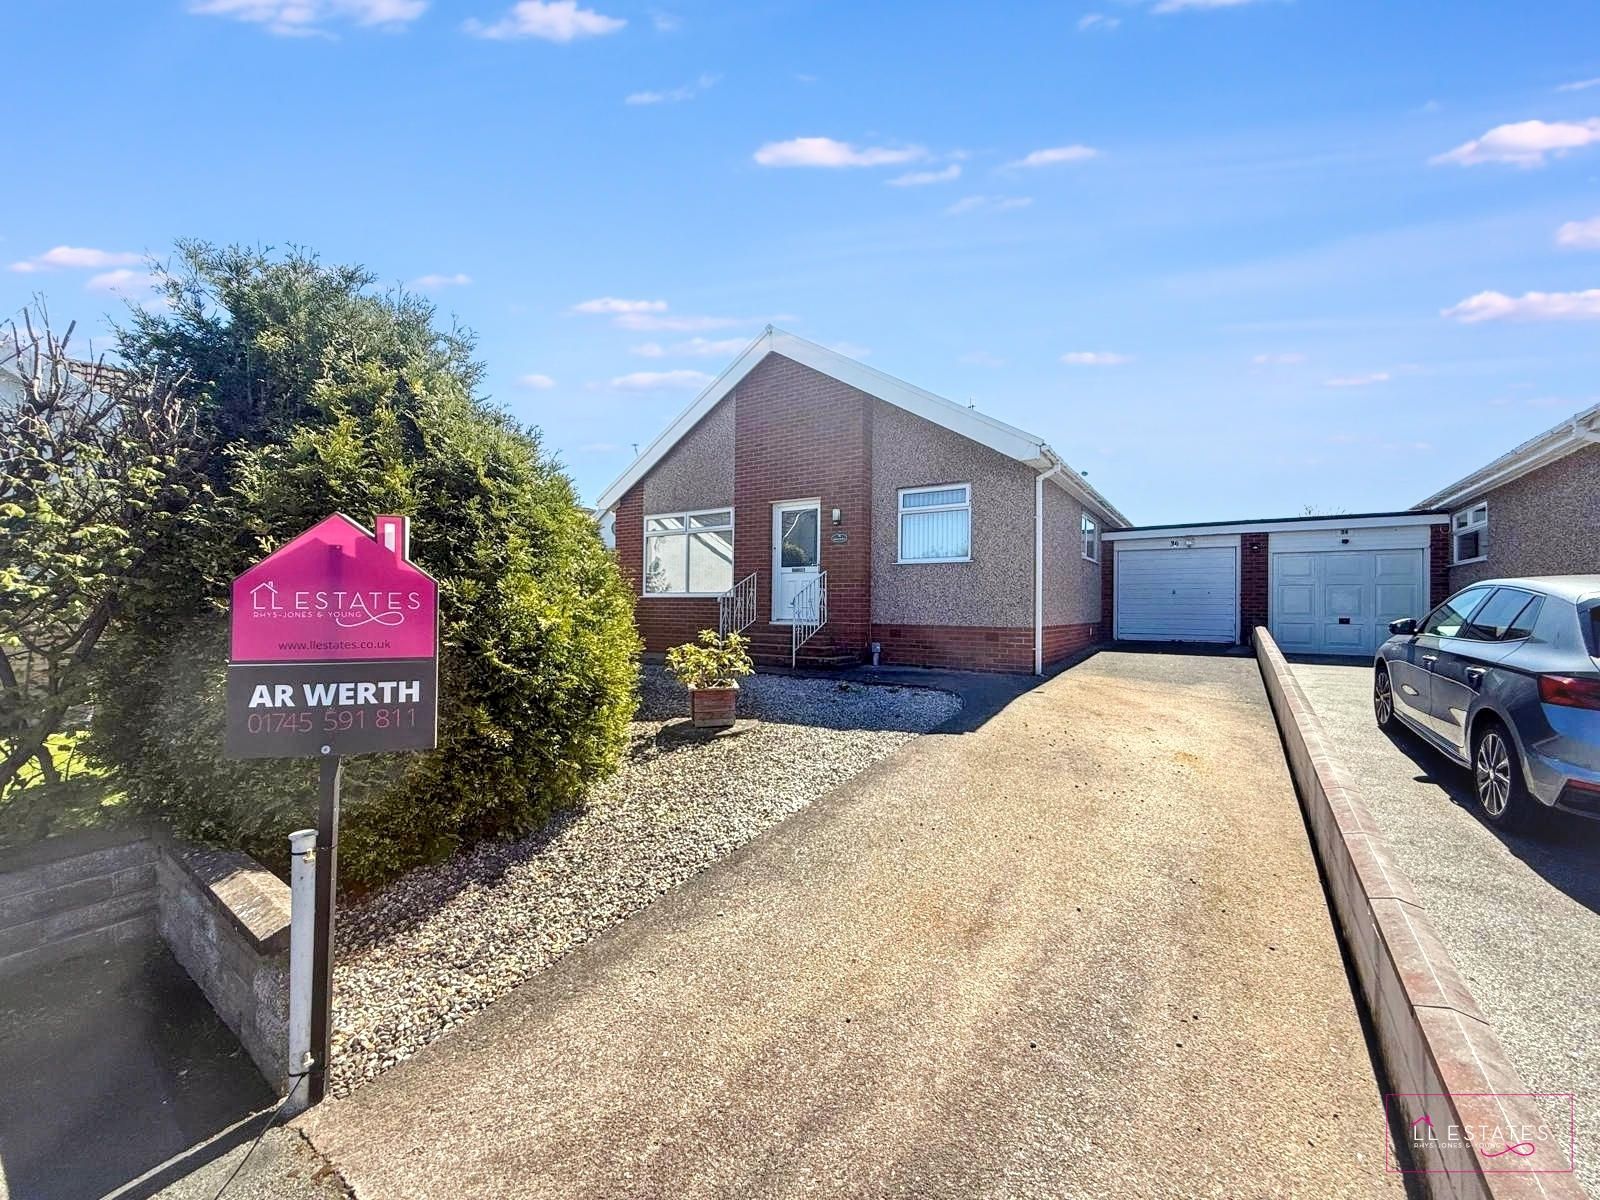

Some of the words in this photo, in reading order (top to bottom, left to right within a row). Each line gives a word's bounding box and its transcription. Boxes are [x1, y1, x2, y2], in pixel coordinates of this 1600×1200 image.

[295, 591, 421, 610] ESTATES
[253, 611, 313, 619] RHYS-JONES
[316, 611, 324, 619] &
[327, 611, 362, 619] YOUNG
[278, 639, 391, 651] www.llestates.co.uk
[248, 684, 296, 708] AR
[302, 681, 419, 706] WERTH
[247, 711, 313, 735] 01745
[323, 709, 365, 732] 591
[375, 708, 415, 729] 811
